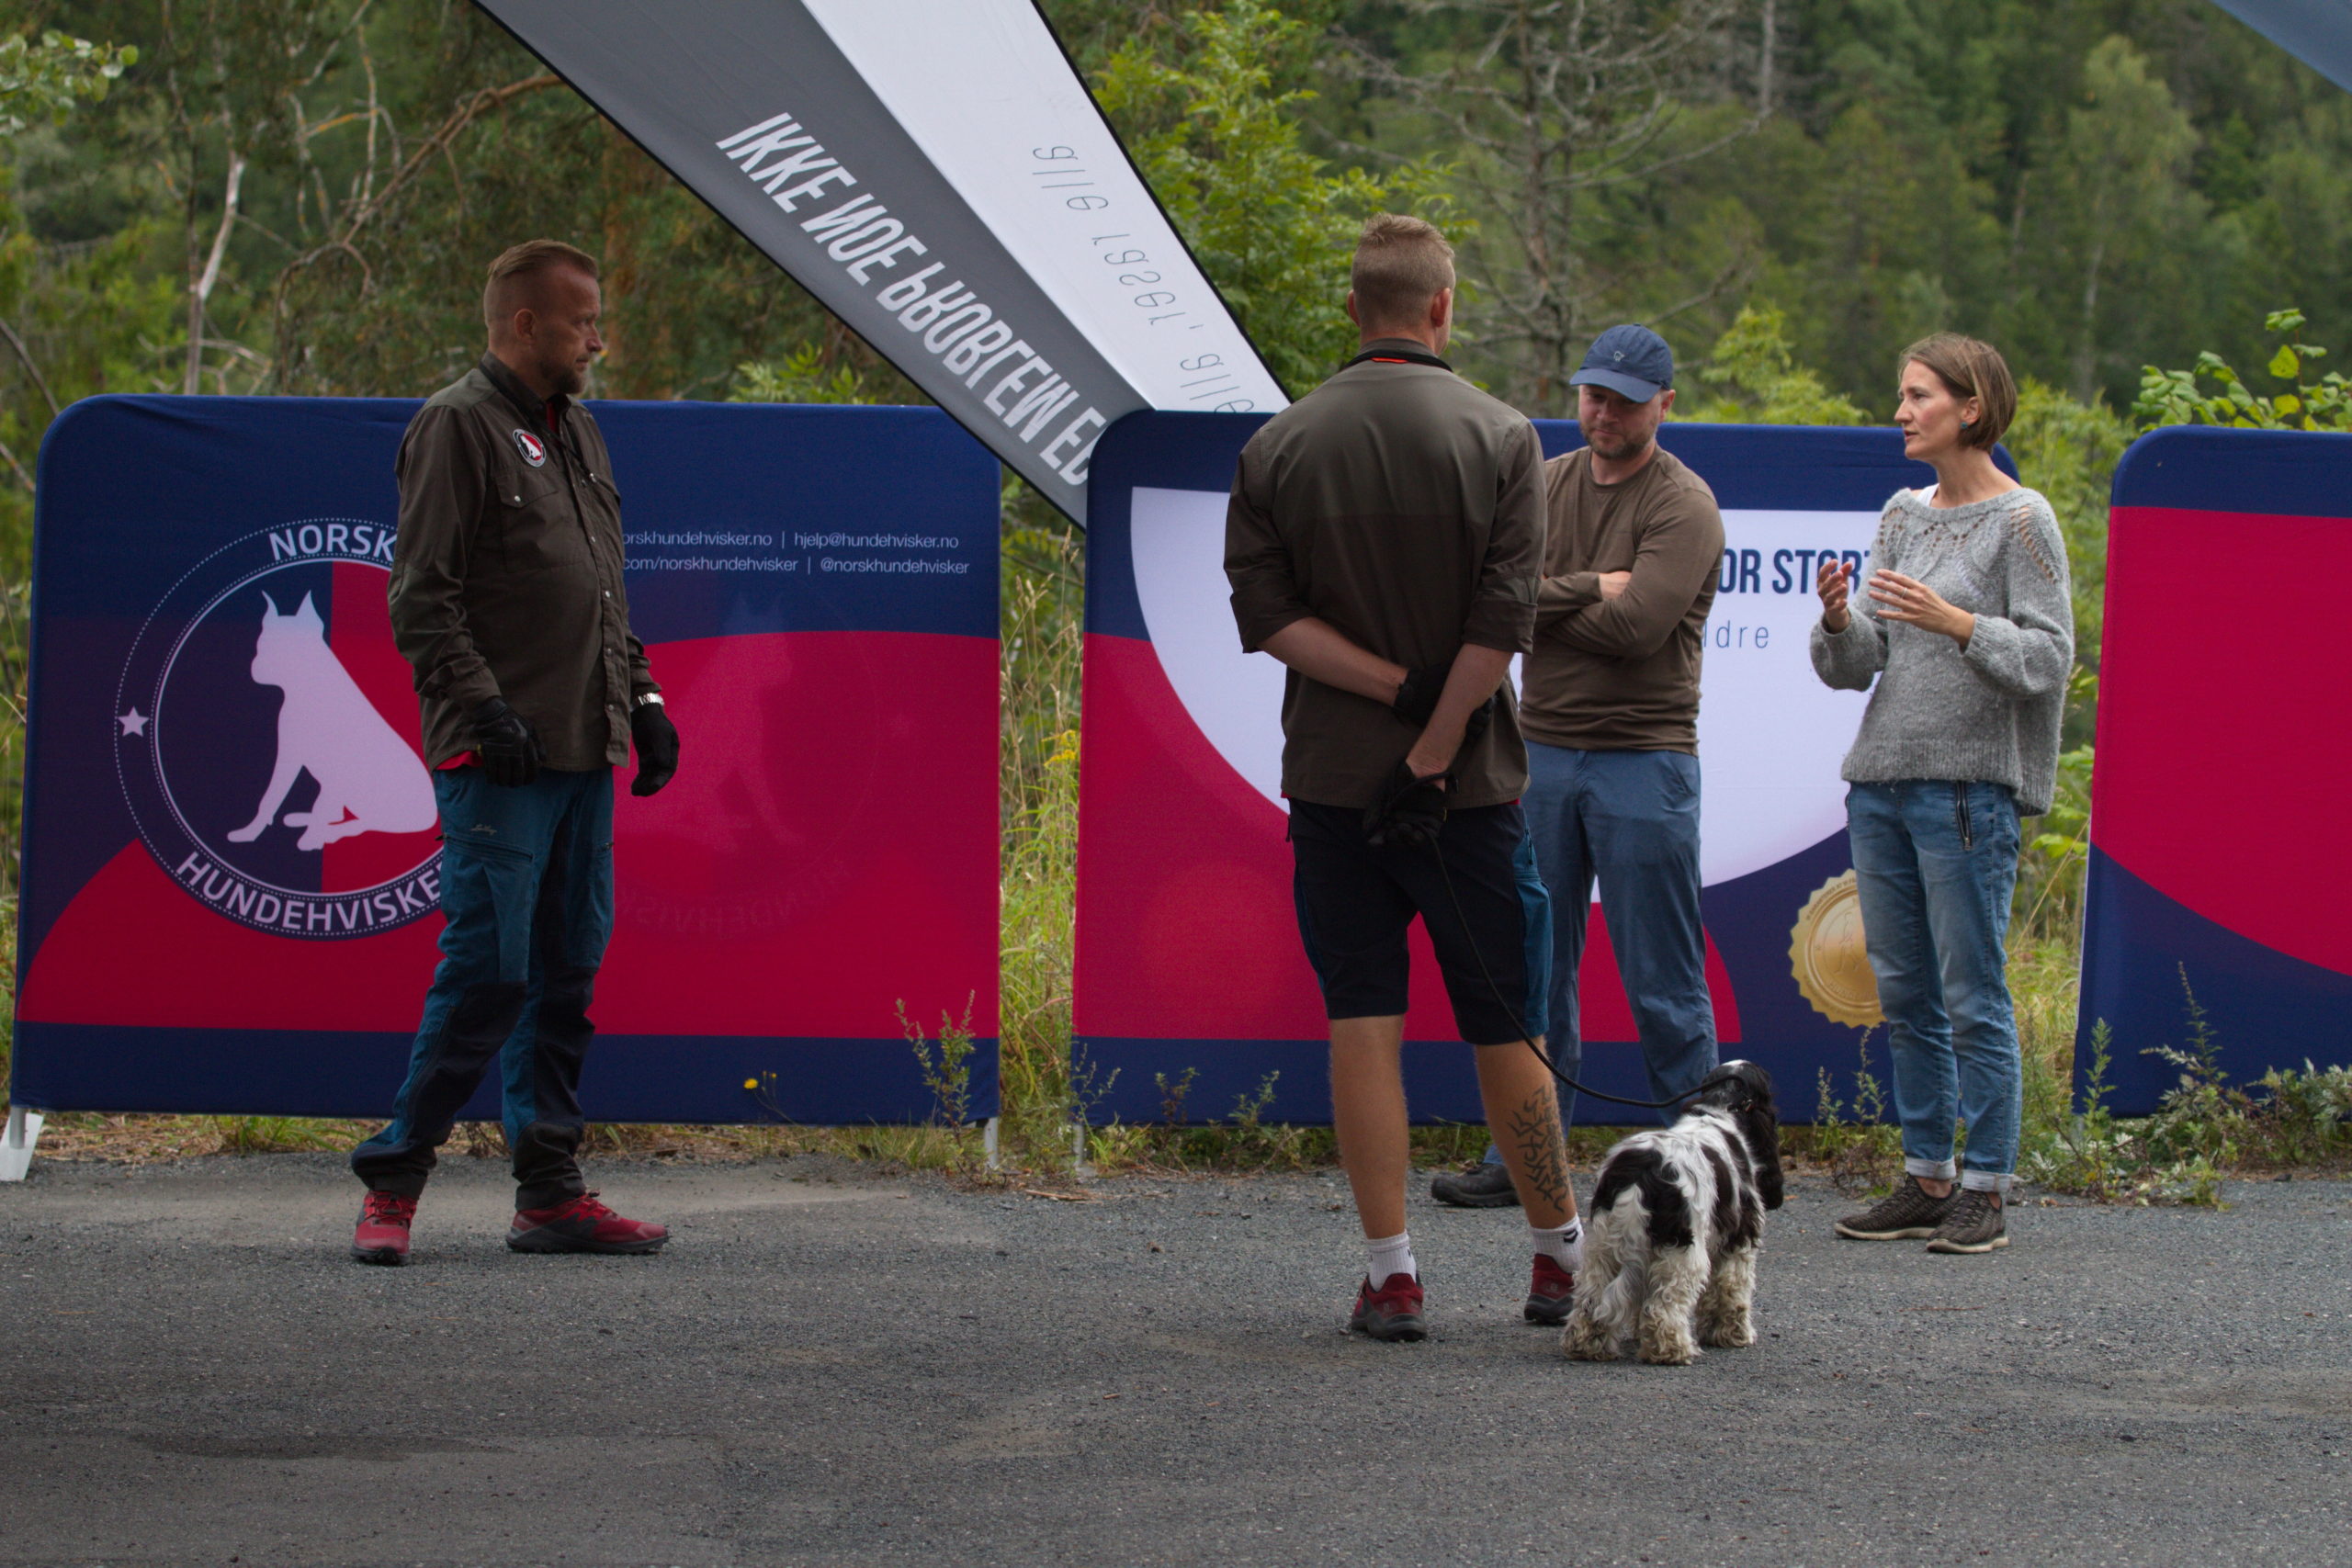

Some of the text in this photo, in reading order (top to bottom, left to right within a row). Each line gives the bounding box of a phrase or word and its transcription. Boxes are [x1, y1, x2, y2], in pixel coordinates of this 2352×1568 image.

[268, 524, 398, 562] NORSK
[794, 532, 959, 549] hjelp@hundehvisker.no
[820, 557, 970, 574] @norskhundehvisker
[175, 852, 443, 932] HUNDEHVISKE
